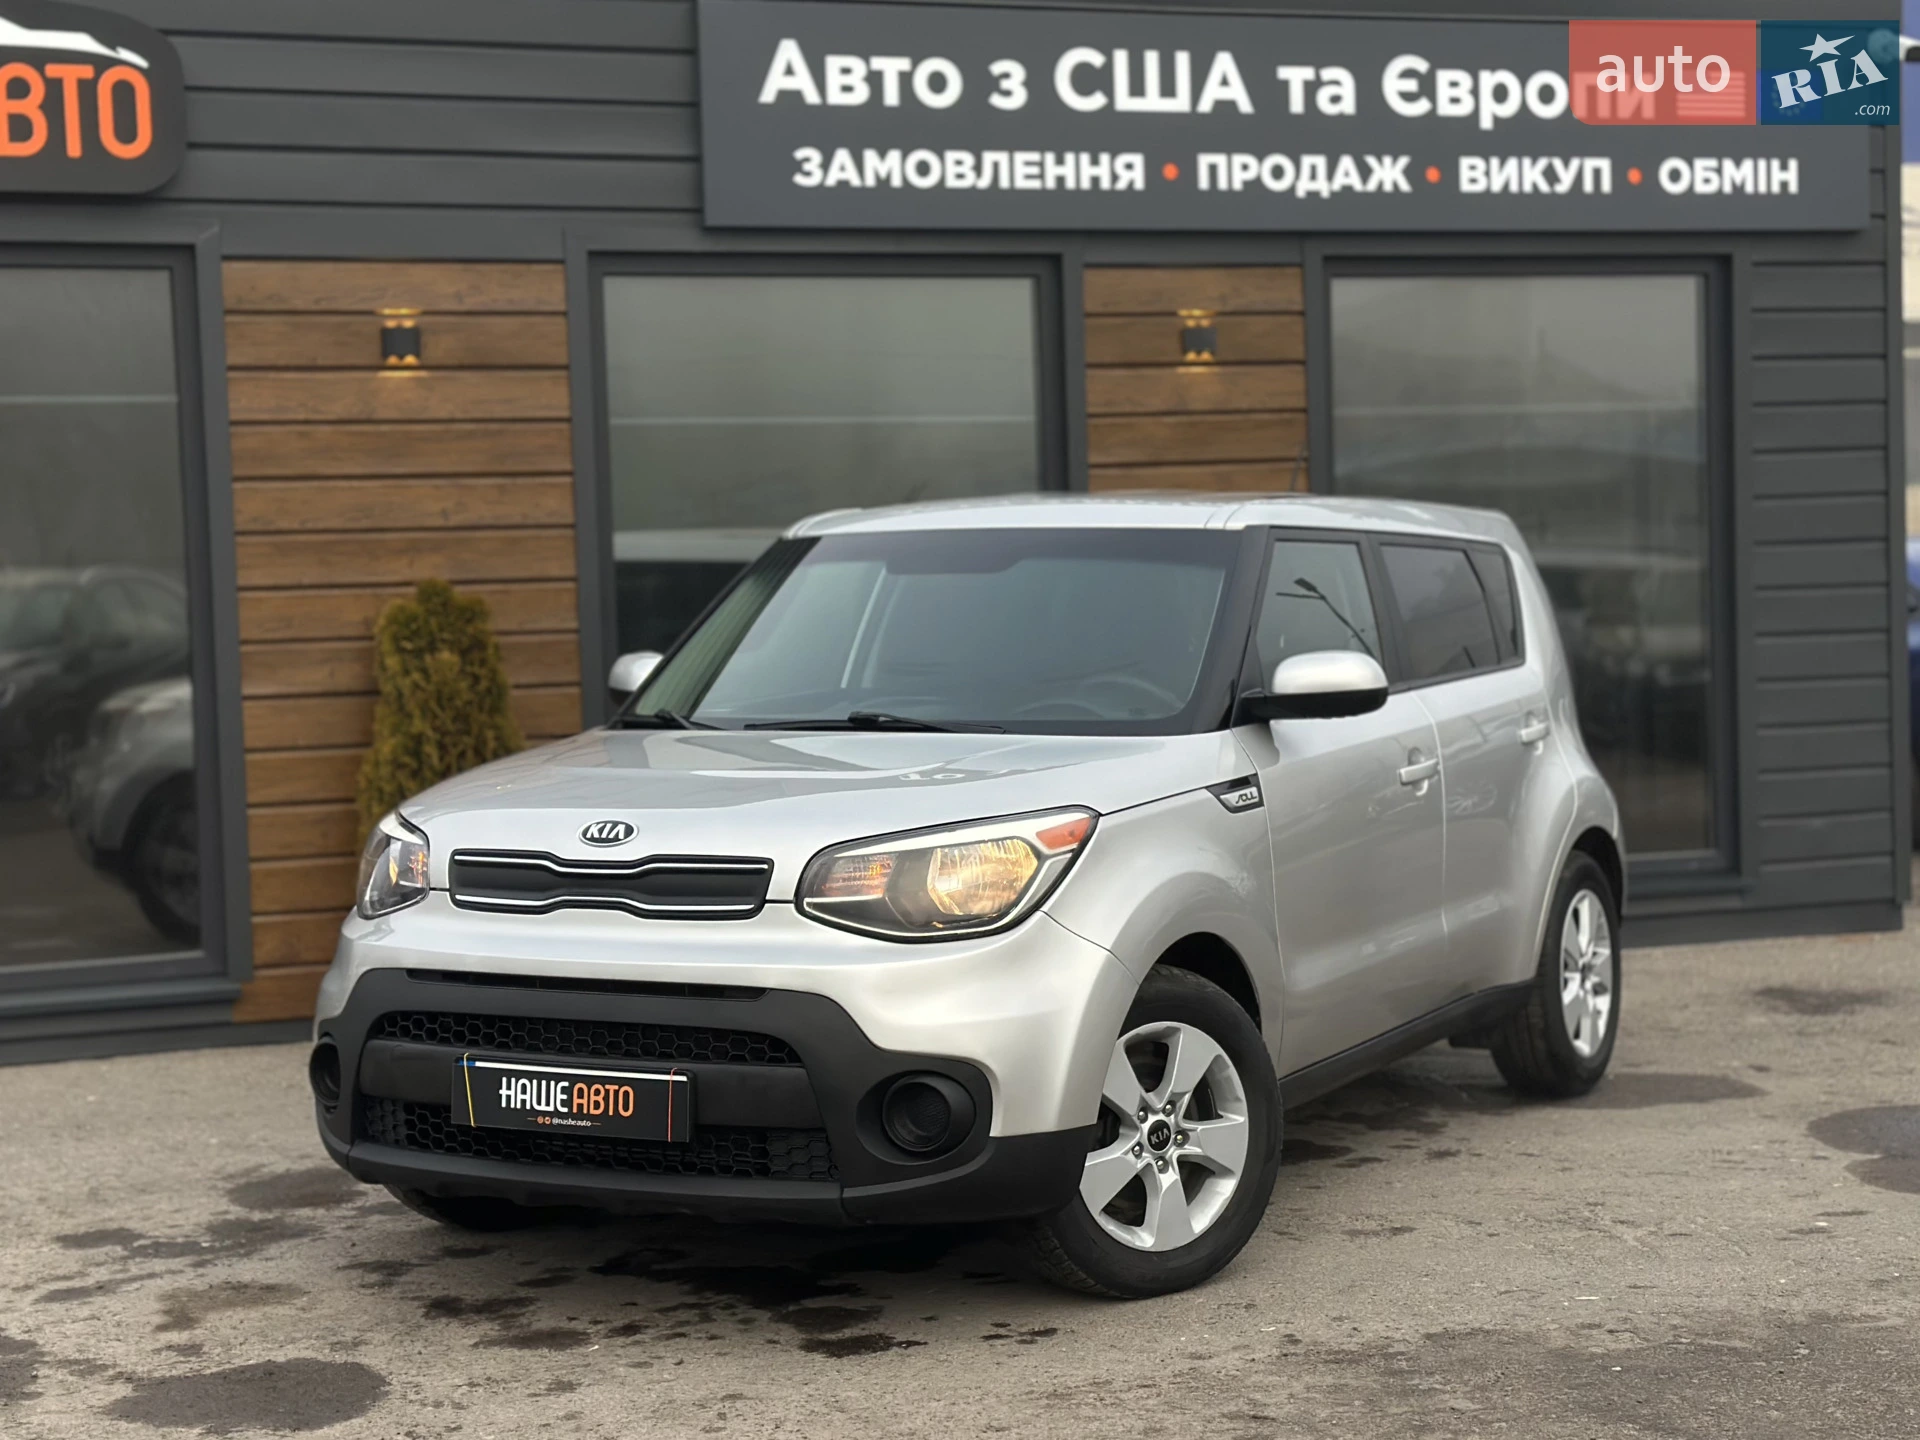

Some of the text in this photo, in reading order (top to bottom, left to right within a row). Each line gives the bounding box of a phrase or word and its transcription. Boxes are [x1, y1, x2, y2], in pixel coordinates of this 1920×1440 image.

[758, 39, 963, 109] Авто
[988, 59, 1028, 110] з
[1053, 47, 1255, 113] США
[1276, 65, 1356, 115] та
[792, 147, 1799, 198] ЗАМОВЛЕННЯ ПРОДАЖ ВИКУП ОБМІН
[585, 823, 626, 840] KIA
[499, 1076, 634, 1117] НАШЕ АВТО
[551, 1116, 592, 1127] @nasheauto
[1150, 1128, 1170, 1145] KIA
